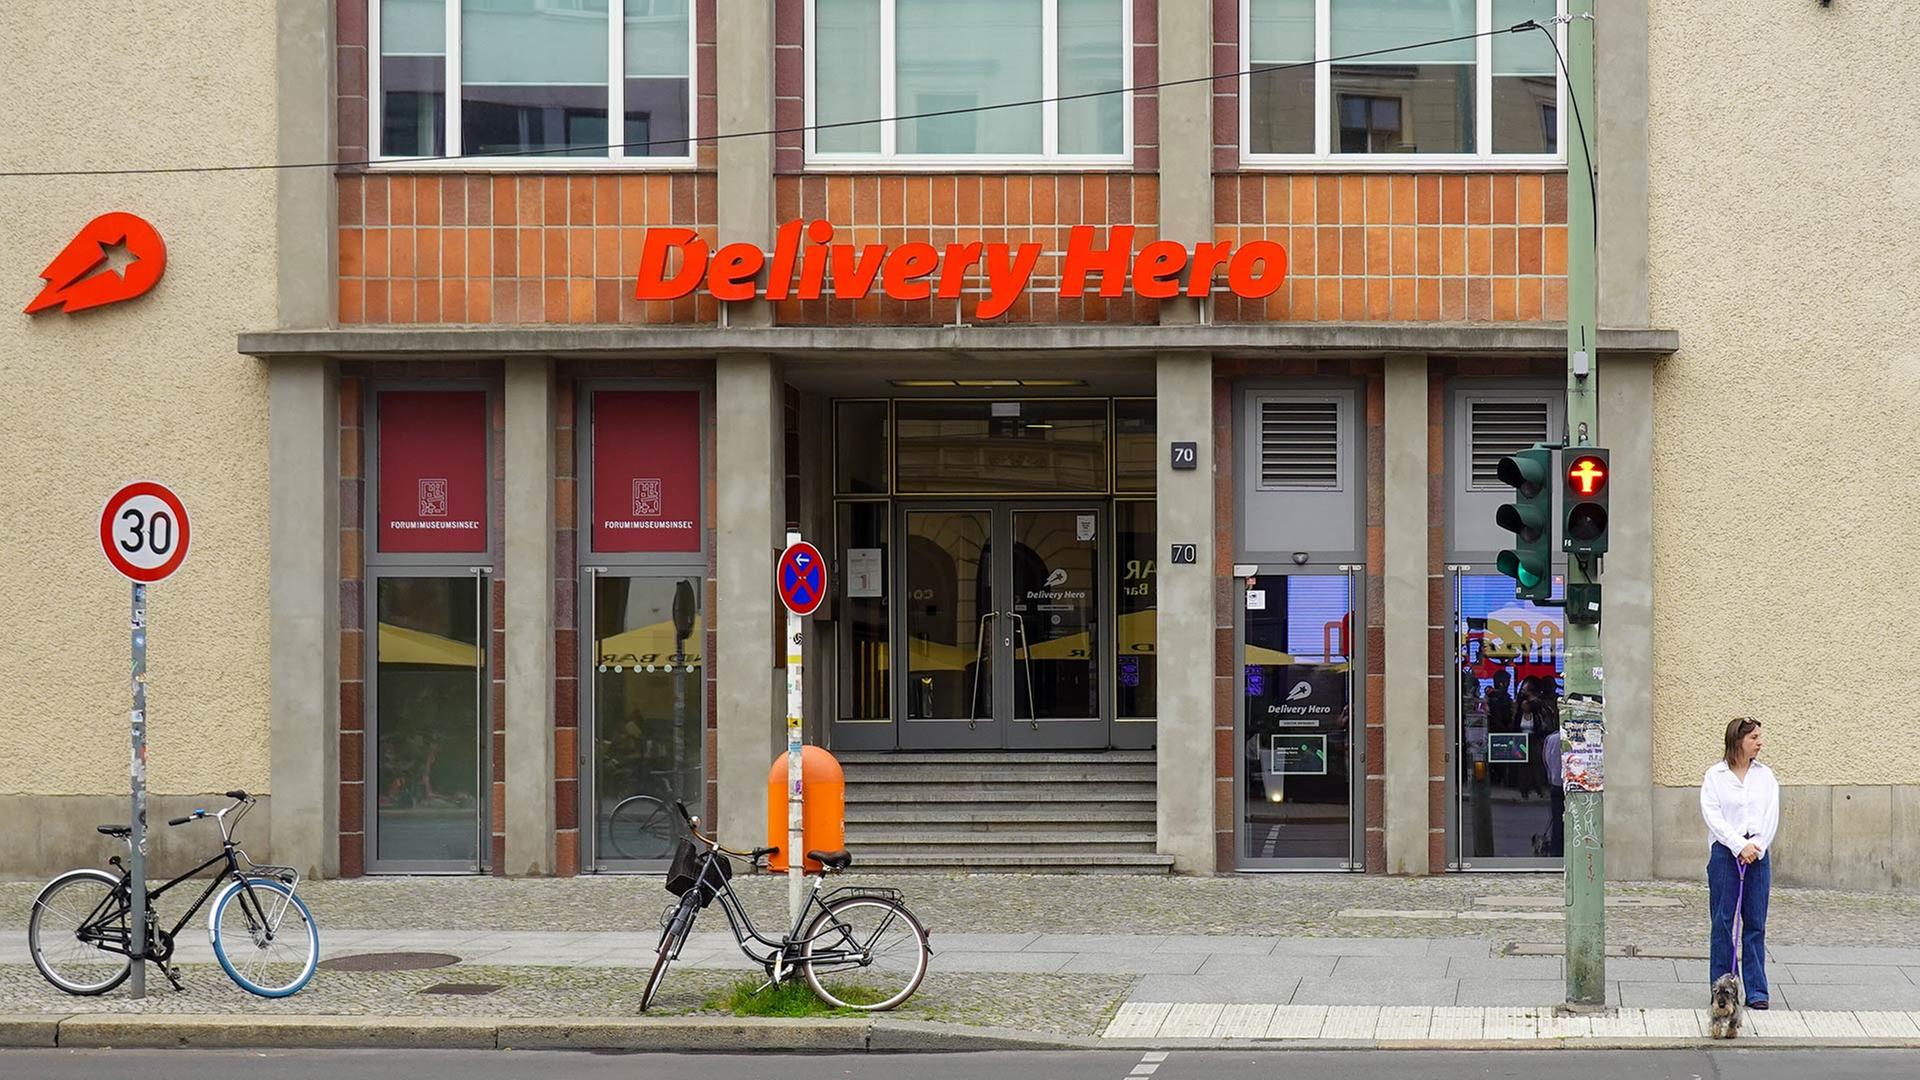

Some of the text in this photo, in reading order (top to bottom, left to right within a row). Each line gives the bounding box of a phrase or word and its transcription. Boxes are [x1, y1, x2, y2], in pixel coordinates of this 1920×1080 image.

[635, 218, 1287, 320] Delivery Hero
[1174, 448, 1193, 462] 70
[120, 508, 172, 555] 30
[1173, 545, 1195, 562] 70
[1026, 590, 1086, 600] Delivery Hero
[1268, 704, 1331, 715] Delivery Hero
